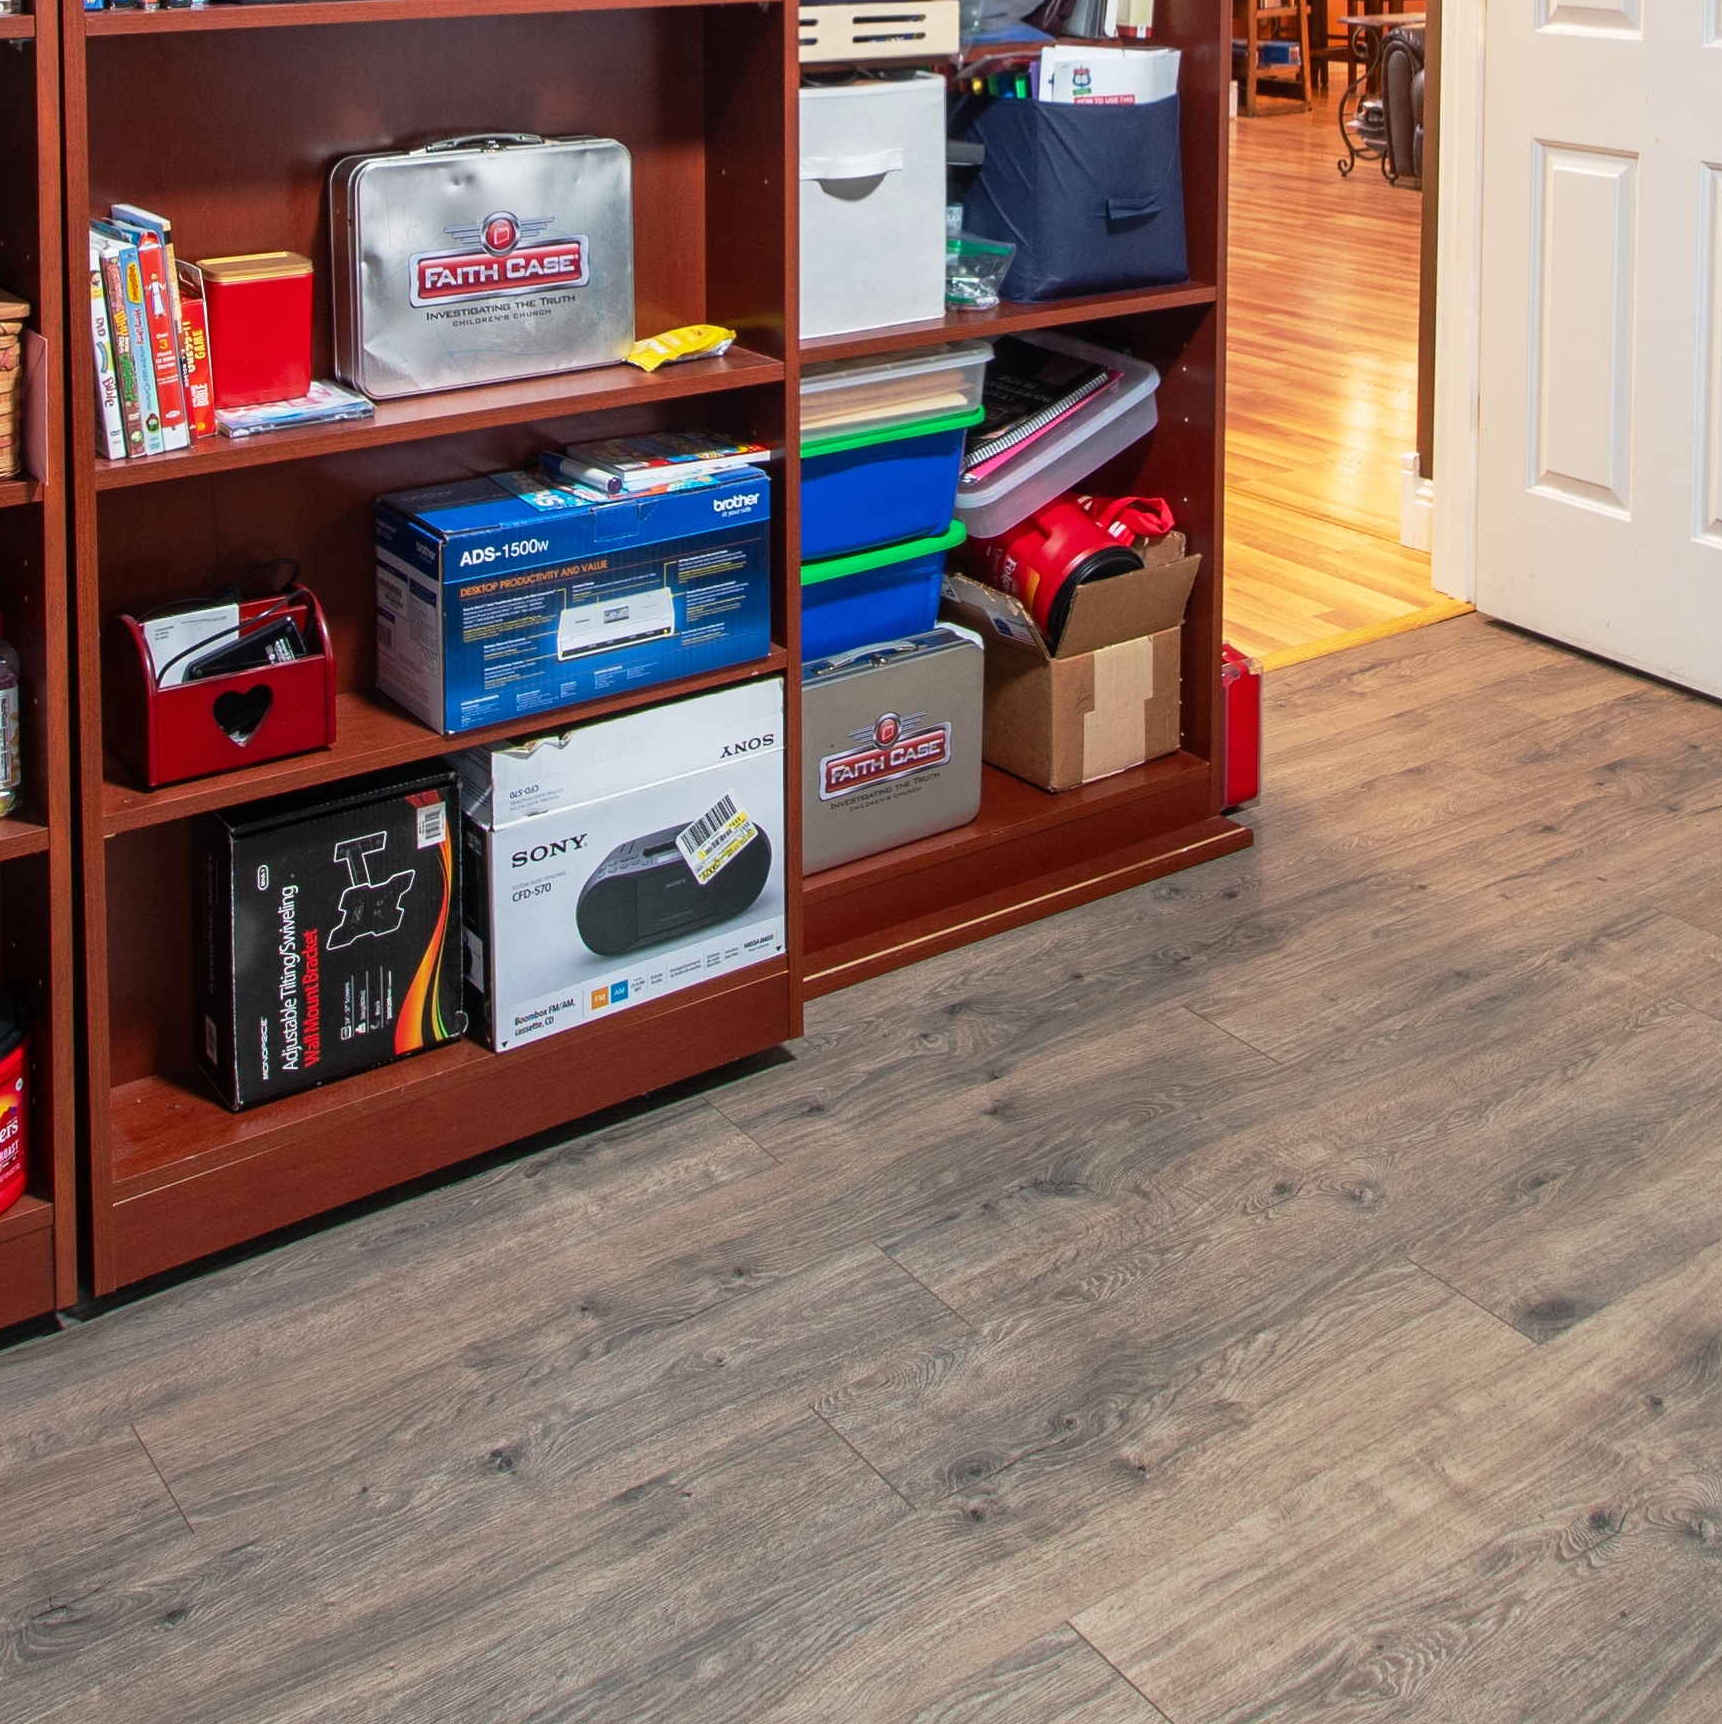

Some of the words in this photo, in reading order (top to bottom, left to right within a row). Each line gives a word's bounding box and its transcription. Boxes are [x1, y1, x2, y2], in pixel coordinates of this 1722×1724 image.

[425, 264, 498, 288] FAITH
[507, 255, 575, 278] CASE
[426, 303, 511, 320] INVESTIGATING
[515, 300, 536, 309] THE
[539, 294, 575, 305] TRUTH
[452, 315, 509, 327] CHILDREN'S
[514, 309, 551, 319] CHURCH
[193, 330, 205, 359] GAME
[96, 317, 105, 336] DVD
[103, 377, 115, 407] Bible
[194, 383, 208, 406] BIBLE
[713, 492, 759, 512] brother
[460, 583, 496, 597] DESKTOP
[500, 569, 558, 590] PRODUCTIVITY
[560, 565, 579, 576] AND
[582, 559, 607, 572] VALUE
[720, 733, 774, 758] SONY
[831, 756, 885, 784] FAITH
[890, 740, 940, 766] CASE
[512, 834, 587, 868] SONY
[512, 883, 551, 902] CFD-S70
[278, 886, 300, 997] Tilting/Swiveling
[302, 928, 318, 981] Bracket
[304, 984, 319, 1033] Mount
[594, 993, 606, 1003] FM
[614, 987, 625, 996] AM
[514, 1007, 547, 1026] Boombox
[549, 999, 575, 1014] FM/AM,
[281, 999, 302, 1070] Adjustable
[304, 1035, 320, 1067] Wall
[0, 1139, 20, 1162] ROAST
